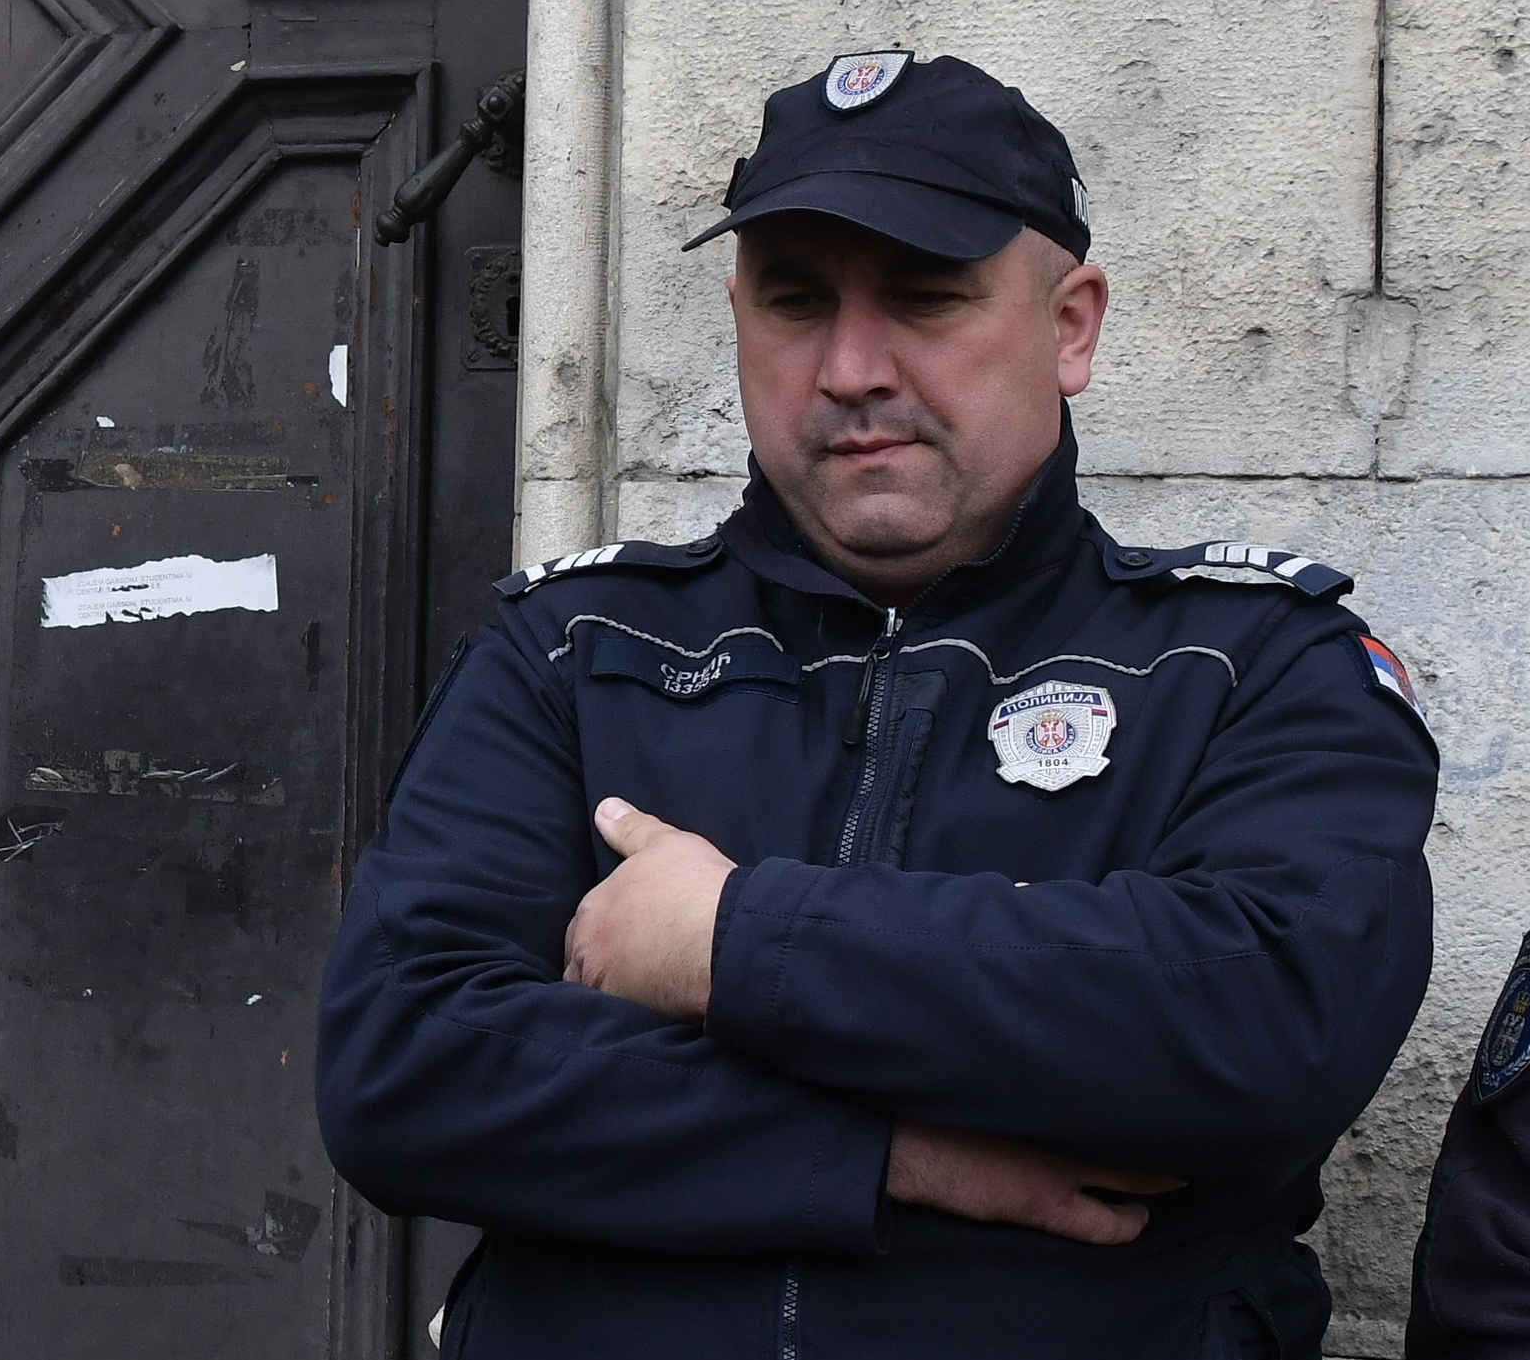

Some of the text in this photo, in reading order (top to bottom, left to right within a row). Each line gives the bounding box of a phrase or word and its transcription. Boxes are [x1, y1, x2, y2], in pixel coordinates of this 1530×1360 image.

[660, 651, 732, 684] СРНИЋ
[1005, 692, 1095, 714] ПОЛИЦИЈА
[1038, 758, 1069, 768] 1804
